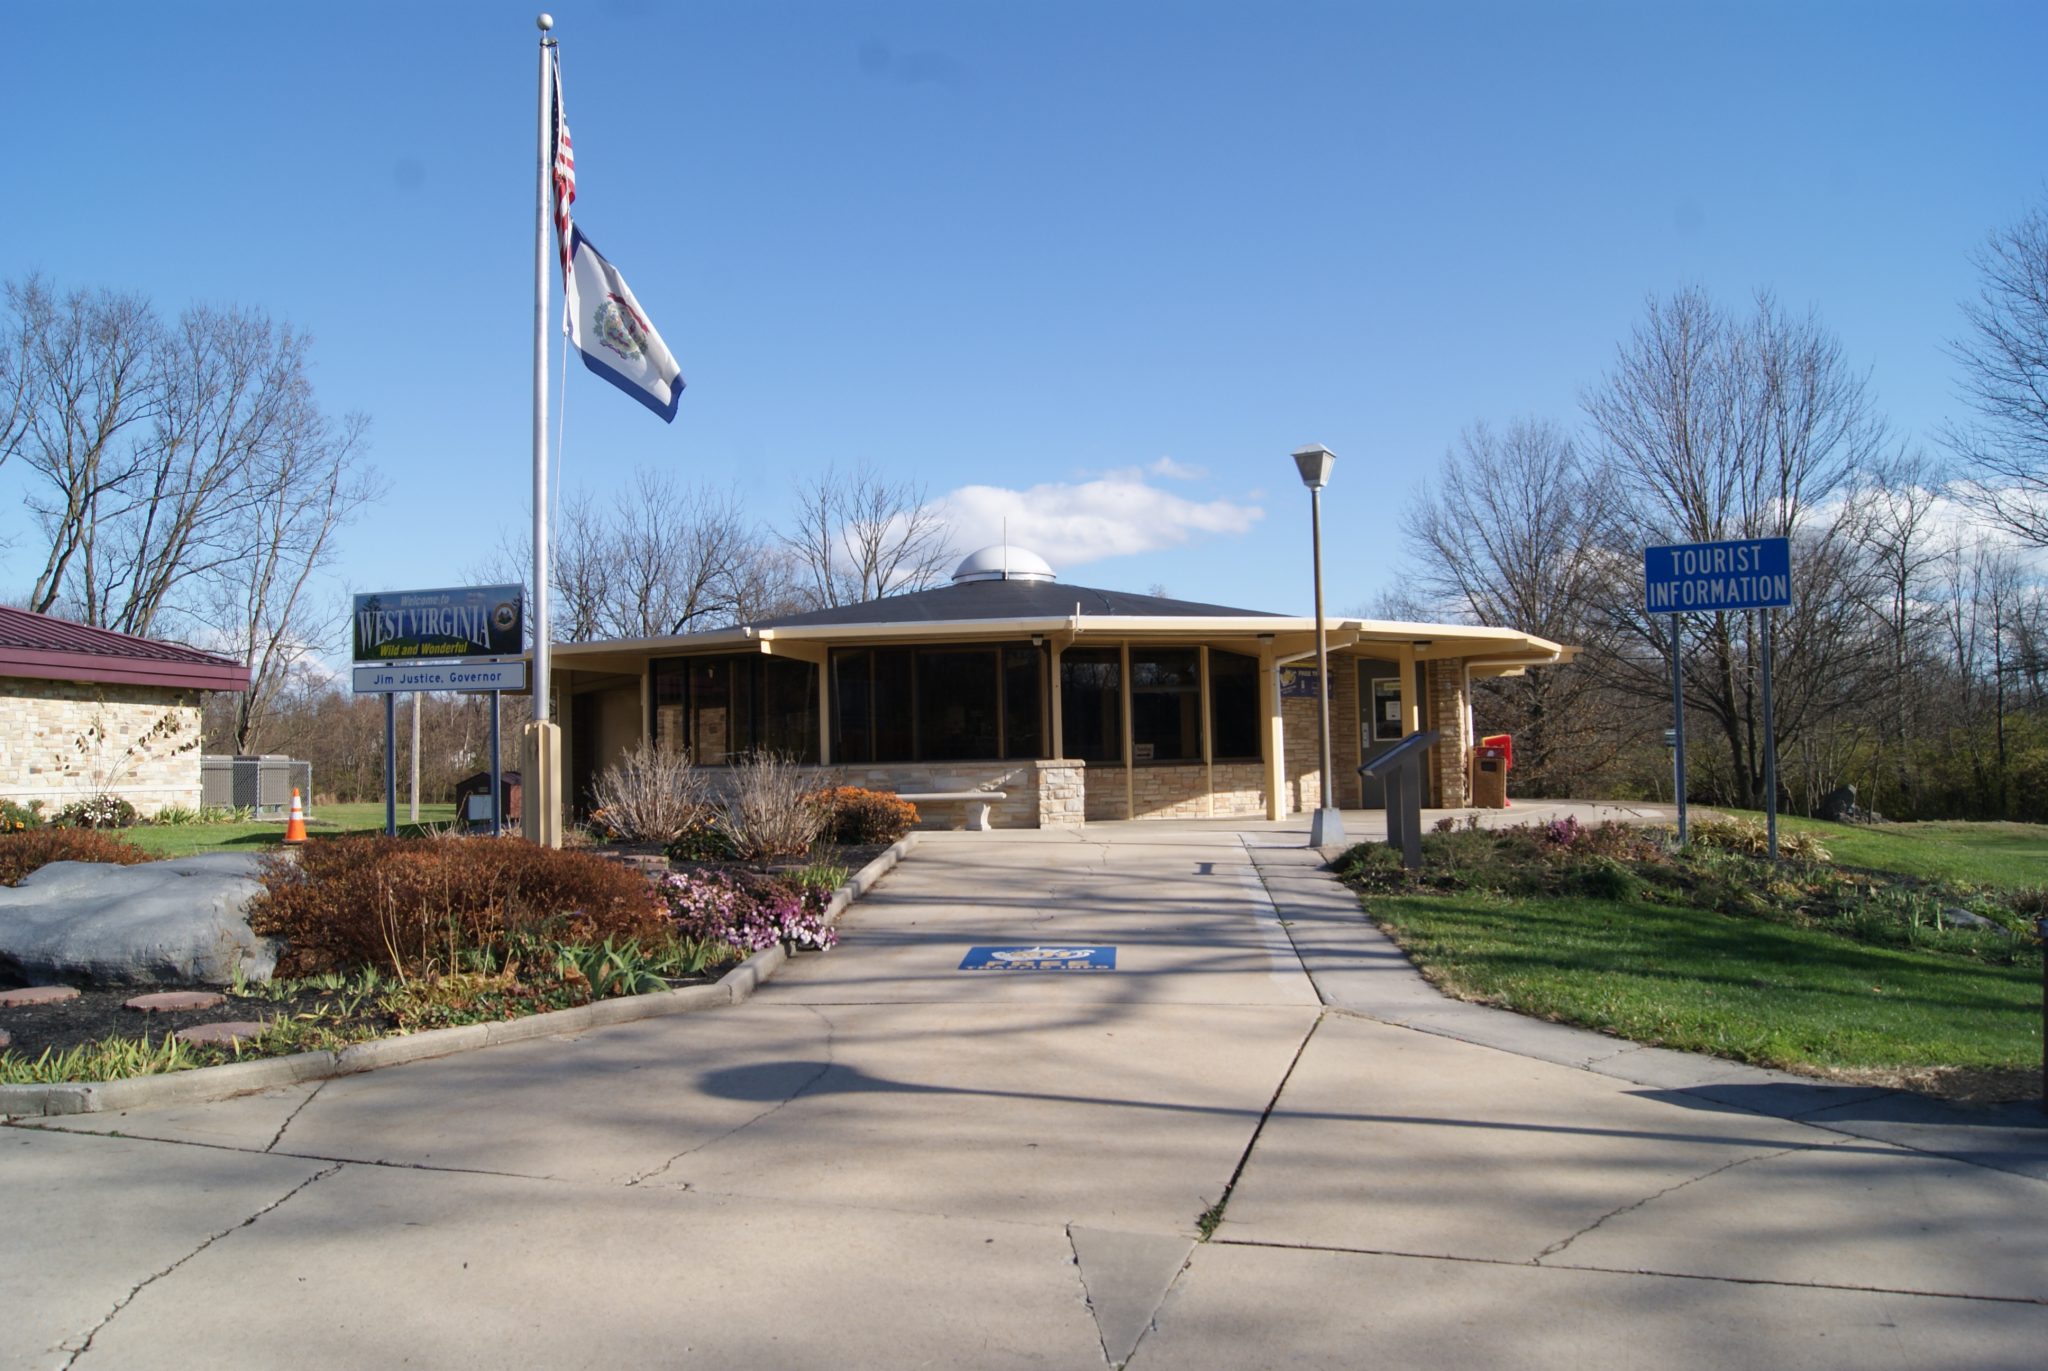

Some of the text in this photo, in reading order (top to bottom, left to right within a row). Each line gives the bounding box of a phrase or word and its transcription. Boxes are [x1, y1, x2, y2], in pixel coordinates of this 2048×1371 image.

[1671, 545, 1761, 575] TOURIST
[401, 594, 449, 606] Welcome to
[1650, 575, 1787, 607] INFORMATION
[359, 604, 491, 652] WEST VIRGINIA
[380, 641, 468, 656] Wild and Wonderful
[374, 674, 394, 685] Jim
[450, 671, 502, 682] Governor
